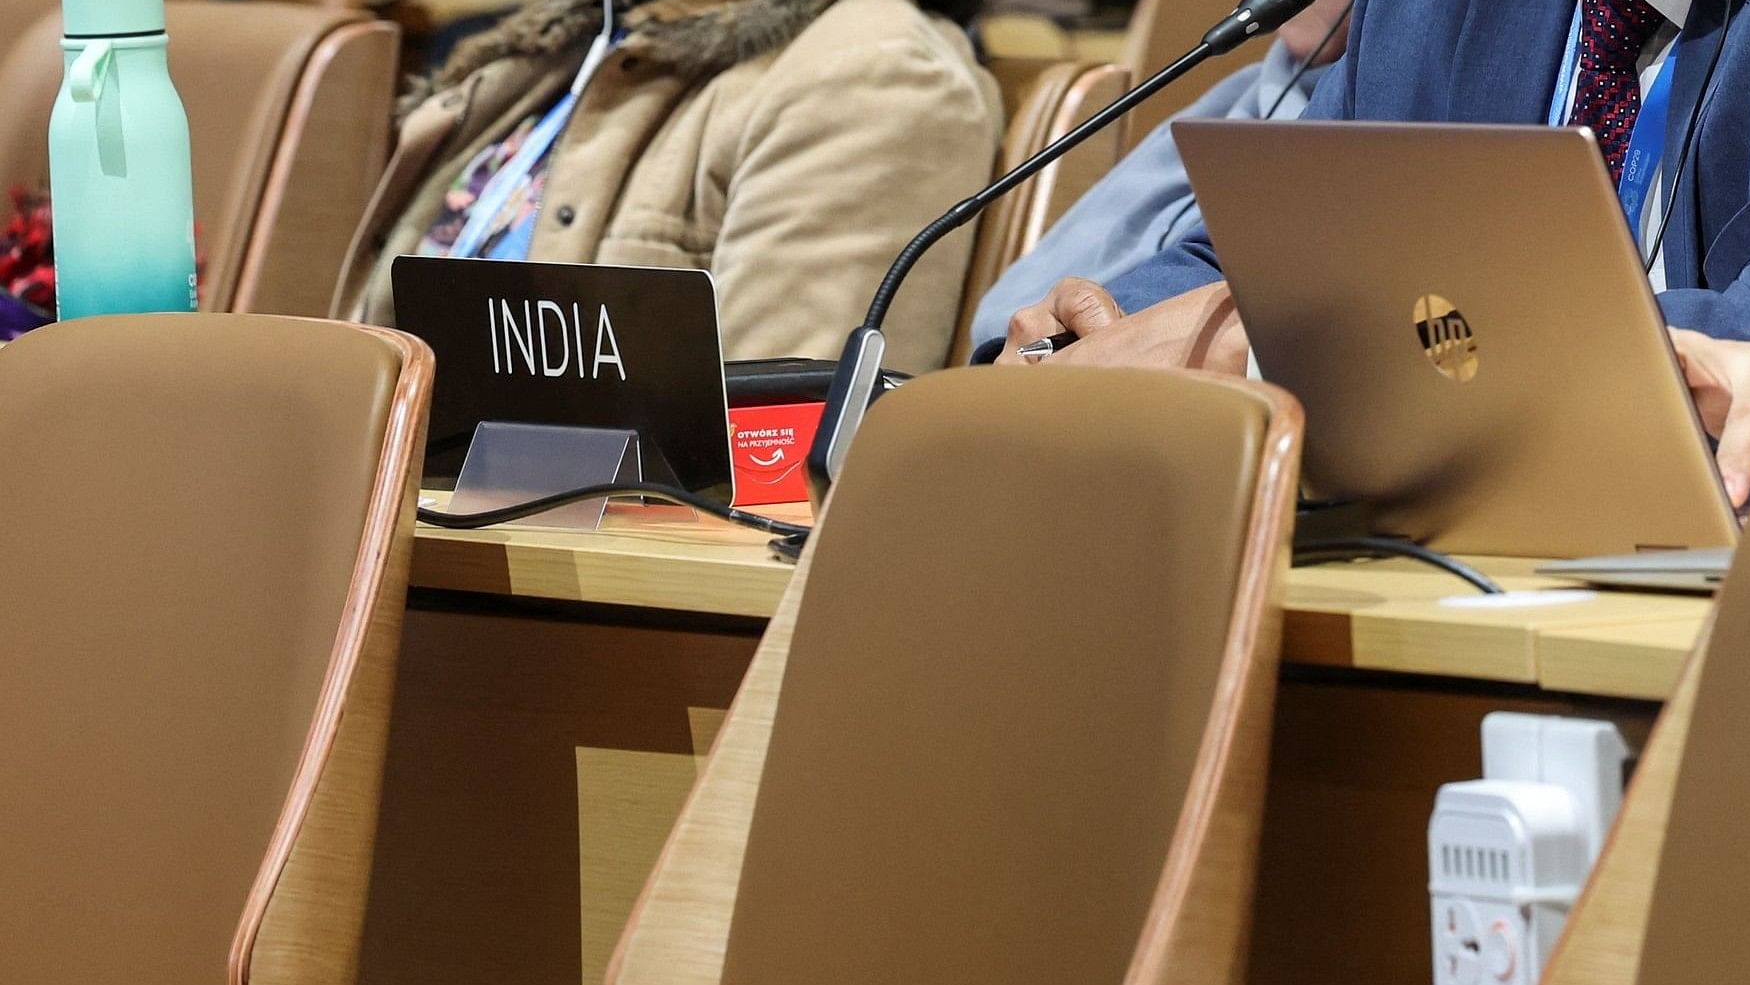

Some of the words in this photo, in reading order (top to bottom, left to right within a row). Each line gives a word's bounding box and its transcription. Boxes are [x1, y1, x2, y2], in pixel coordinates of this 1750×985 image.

[488, 297, 627, 381] INDIA
[1413, 295, 1478, 382] hp
[737, 428, 778, 439] OTWÓRZ
[780, 427, 794, 438] SIĘ
